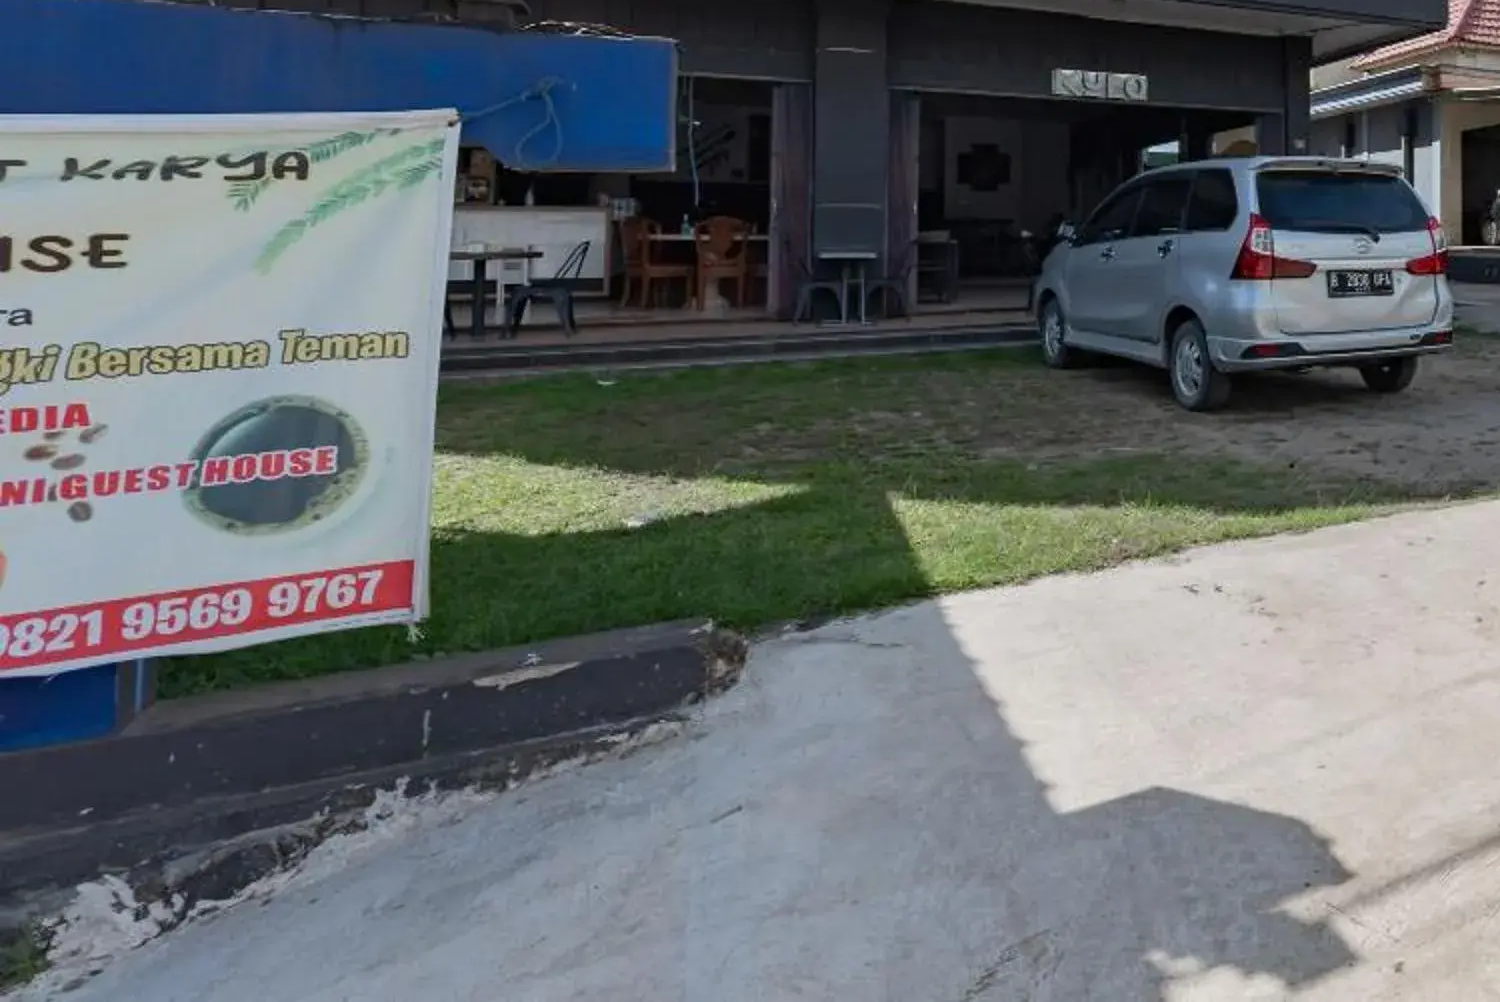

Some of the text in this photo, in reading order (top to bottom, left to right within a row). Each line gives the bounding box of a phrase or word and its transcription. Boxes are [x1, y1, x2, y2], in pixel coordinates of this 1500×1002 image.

[1051, 68, 1148, 102] KULO
[60, 148, 311, 182] KARYA
[64, 341, 270, 381] Bersama
[279, 328, 410, 365] Teman
[59, 459, 200, 501] GUEST
[201, 445, 339, 487] HOUSE
[121, 588, 253, 641] 9569
[266, 569, 385, 618] 9767
